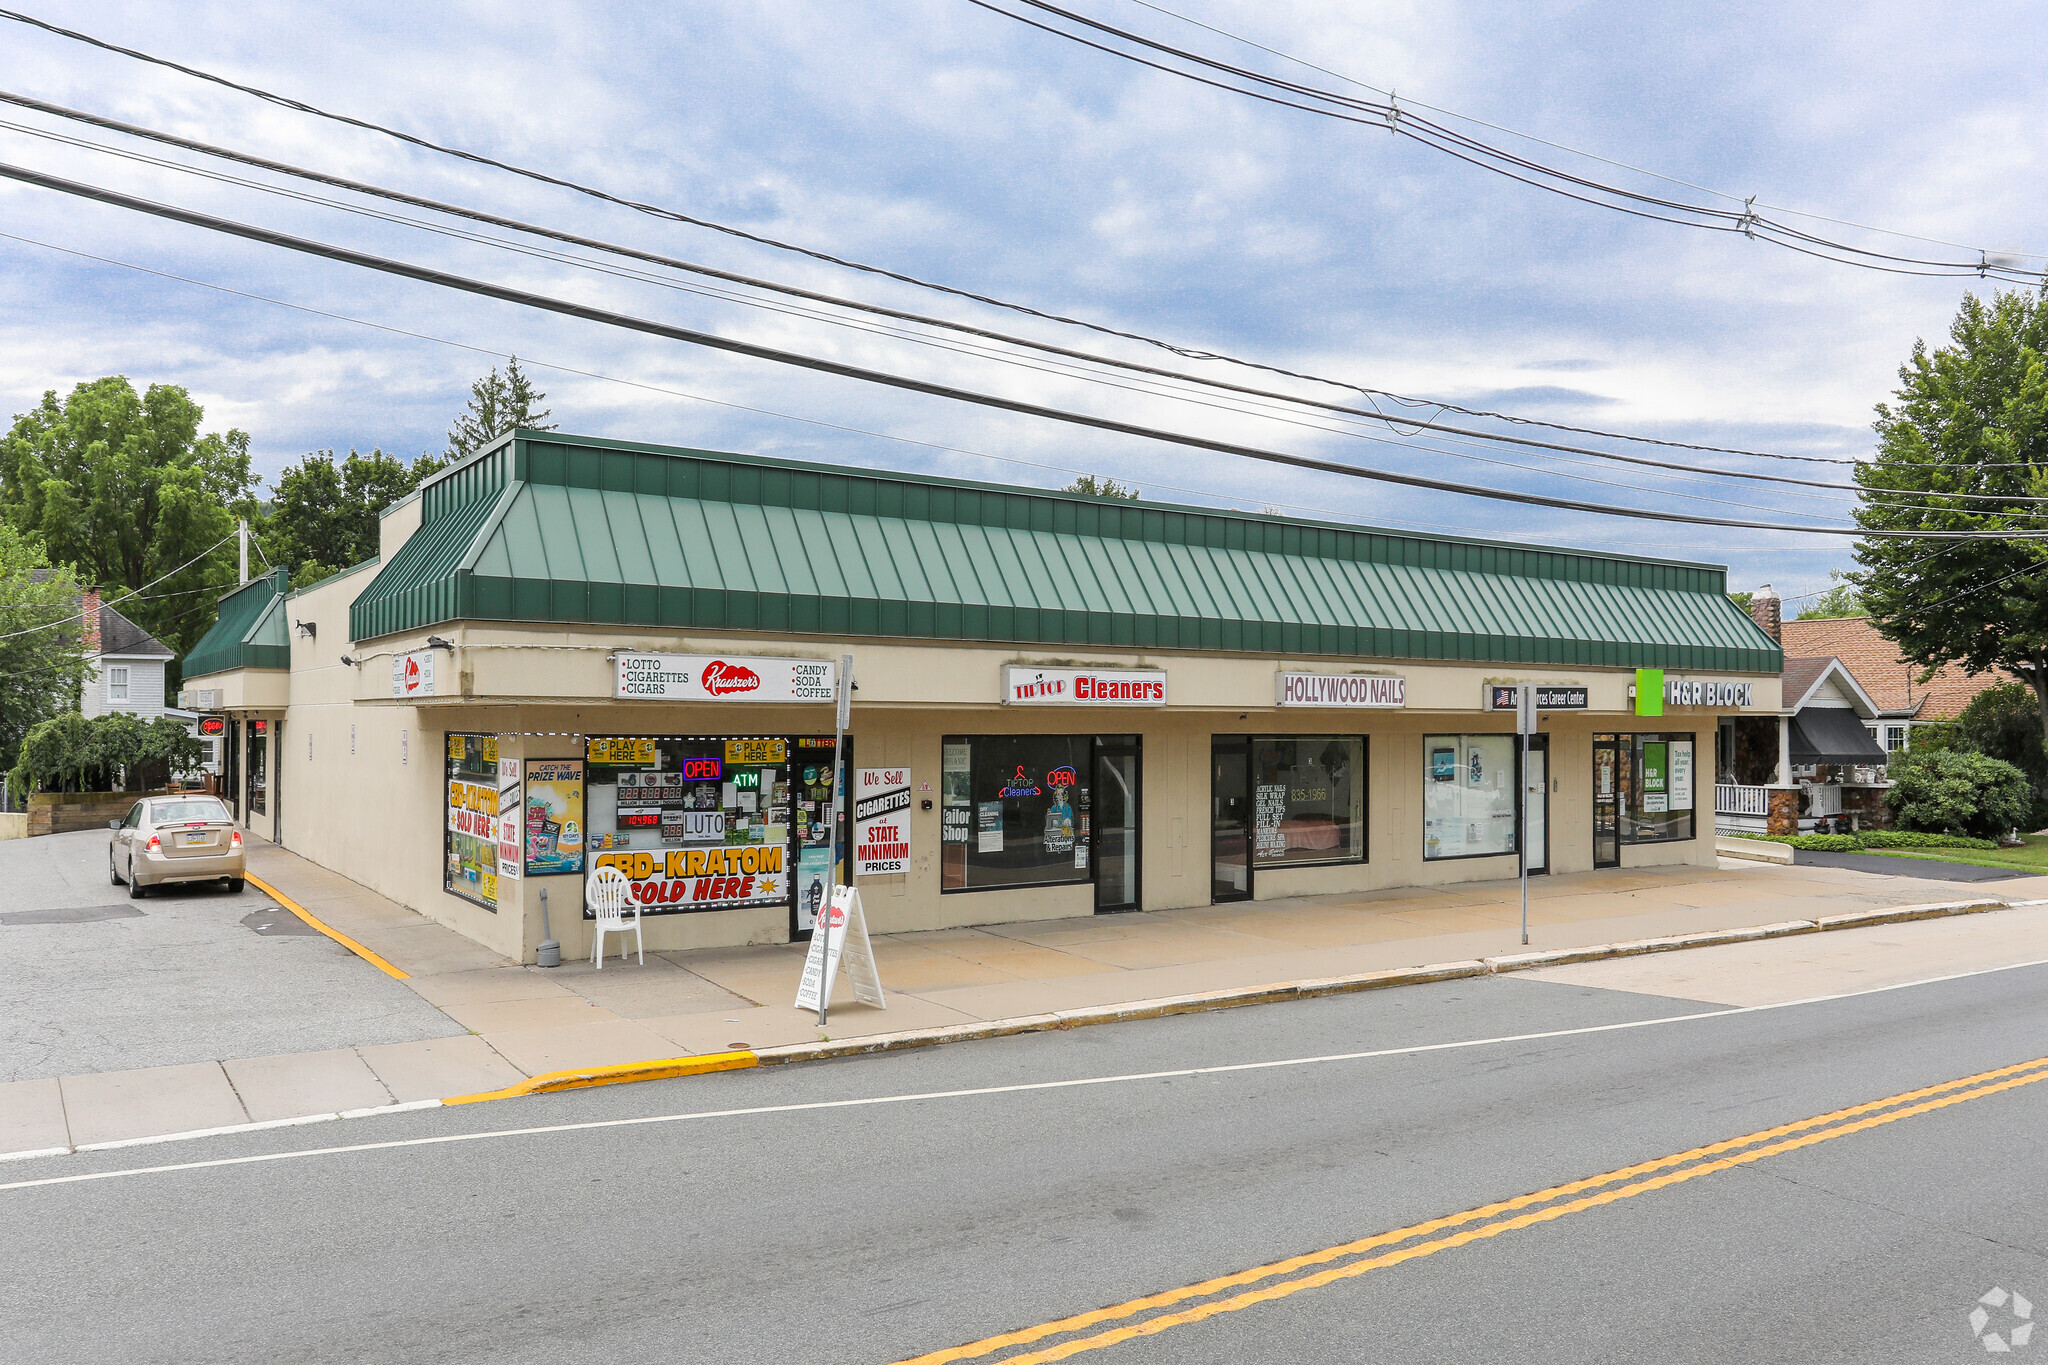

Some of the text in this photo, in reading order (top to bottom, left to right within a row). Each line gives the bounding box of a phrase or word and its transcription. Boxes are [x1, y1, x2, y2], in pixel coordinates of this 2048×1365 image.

[626, 659, 661, 670] LOTTO
[796, 665, 827, 676] CANDY
[626, 671, 689, 683] CIGARETTES
[705, 665, 758, 696] Krauszer's
[796, 677, 821, 687] SODA
[626, 683, 665, 695] CIGARS
[796, 688, 831, 698] COFFEE
[1074, 676, 1164, 701] Cleaners
[1285, 676, 1404, 704] HOLLYWOOD NAILS
[1669, 681, 1753, 706] H&R BLOCK
[1548, 691, 1566, 705] Career
[1567, 691, 1584, 705] Center
[609, 741, 635, 751] PLAY
[744, 742, 768, 752] PLAY
[609, 751, 635, 761] HERE
[744, 751, 768, 761] HERE
[1682, 750, 1690, 758] help
[684, 761, 720, 778] OPEN
[1645, 768, 1657, 777] H&R
[528, 771, 581, 781] PRIZE WAVE
[733, 774, 759, 787] ATM
[864, 771, 903, 786] We Sell
[1047, 771, 1075, 785] OPEN
[1007, 779, 1033, 787] TIPTOP
[1645, 778, 1664, 787] BLOCK
[1004, 787, 1036, 797] Cleaners
[1292, 788, 1326, 800] 835-1966
[856, 790, 910, 819] CIGARETTES
[456, 810, 490, 838] SOLD HERE
[628, 816, 658, 825] 104968
[685, 814, 723, 834] LUTO
[1256, 820, 1281, 828] FILL-IN
[868, 826, 898, 842] STATE
[943, 825, 968, 842] Shop
[1044, 834, 1075, 844] Alterations
[858, 843, 908, 861] MINIMUM
[1052, 843, 1072, 853] Repairs
[595, 846, 783, 883] CBD-KRATOM
[865, 861, 901, 871] PRICES
[625, 876, 755, 906] SOLD HERE
[809, 956, 823, 966] CIGAR
[806, 966, 822, 978] CANDY
[803, 977, 816, 988] SODA
[800, 988, 818, 1000] COFFEE
